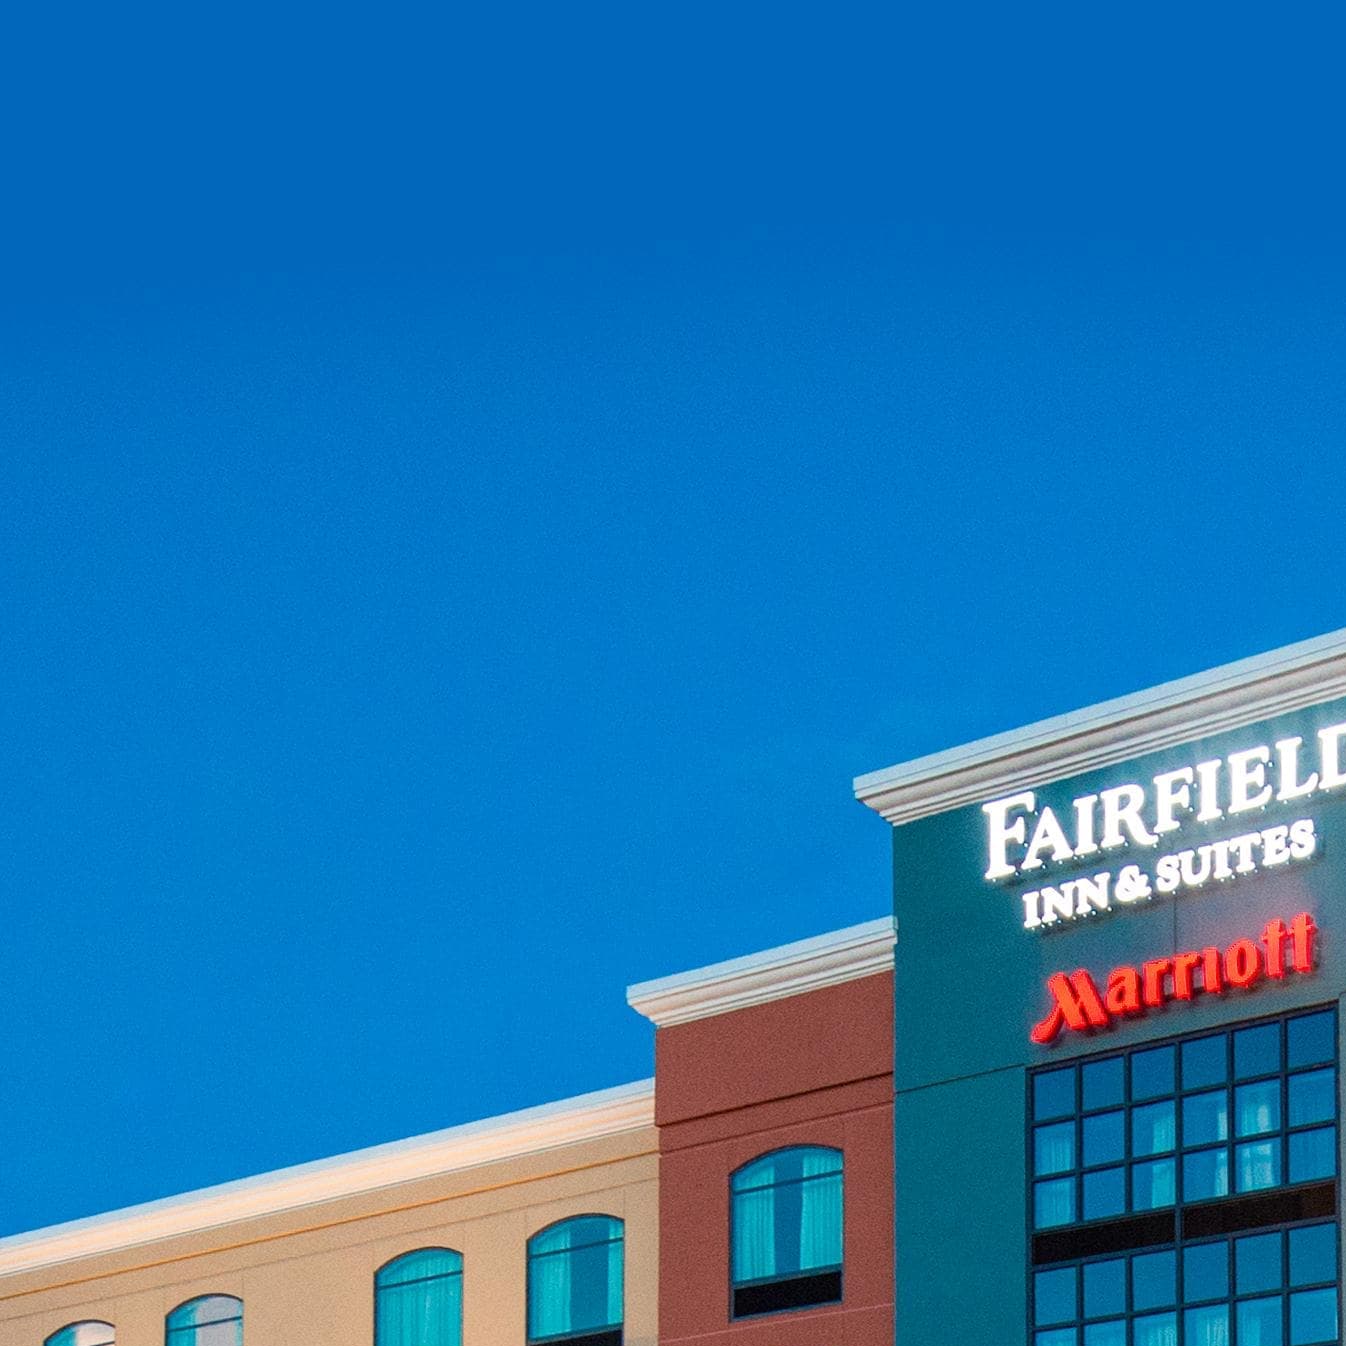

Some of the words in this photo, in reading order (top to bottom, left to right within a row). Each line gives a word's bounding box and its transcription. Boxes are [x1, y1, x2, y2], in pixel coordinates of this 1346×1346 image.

[1022, 871, 1111, 929] INN
[1114, 864, 1152, 902] &
[1155, 819, 1317, 893] SUITES
[1030, 912, 1318, 1044] Marriott
